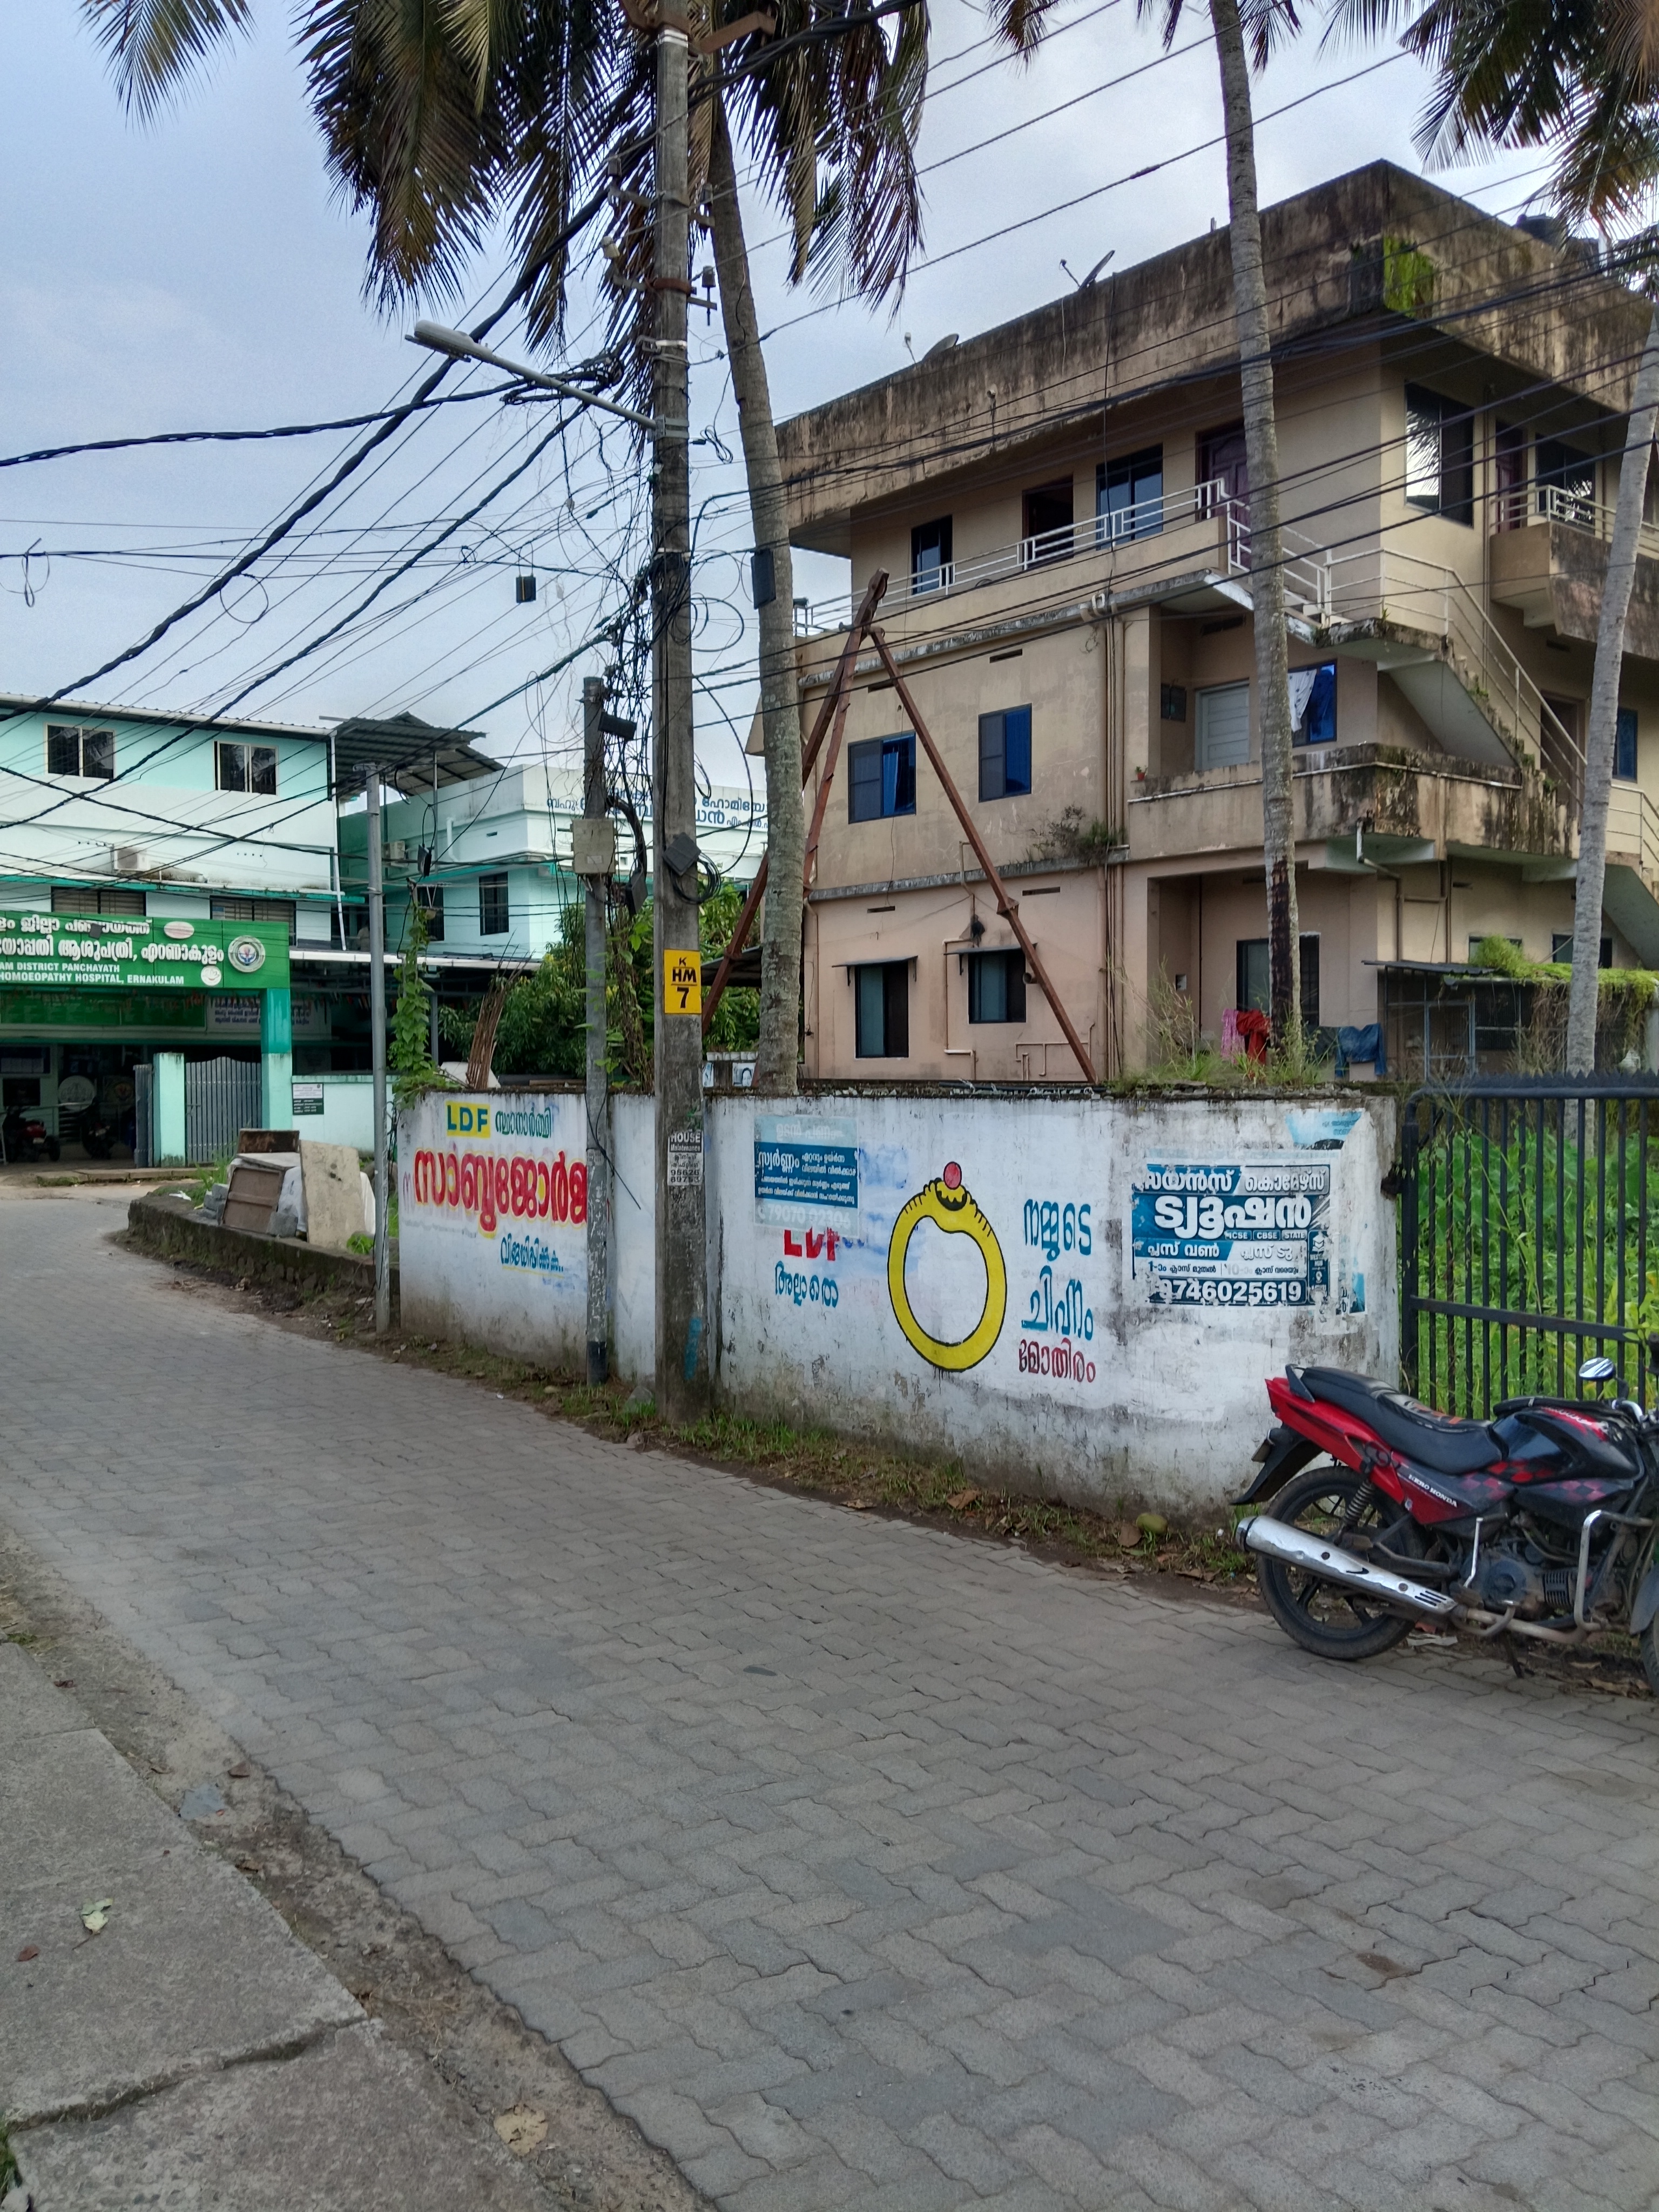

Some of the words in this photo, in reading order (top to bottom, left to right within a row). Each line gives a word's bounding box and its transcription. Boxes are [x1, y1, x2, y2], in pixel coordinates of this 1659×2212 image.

[17, 962, 59, 971] DISTRICT
[62, 963, 120, 973] PANCHAYATH
[679, 957, 687, 967] K
[127, 975, 184, 984] ERNAKULAM
[672, 968, 697, 982] HM
[677, 987, 689, 1008] 7
[447, 1105, 488, 1132] LDF
[670, 1130, 700, 1143] HOUSE
[1430, 1487, 1458, 1508] HONDA
